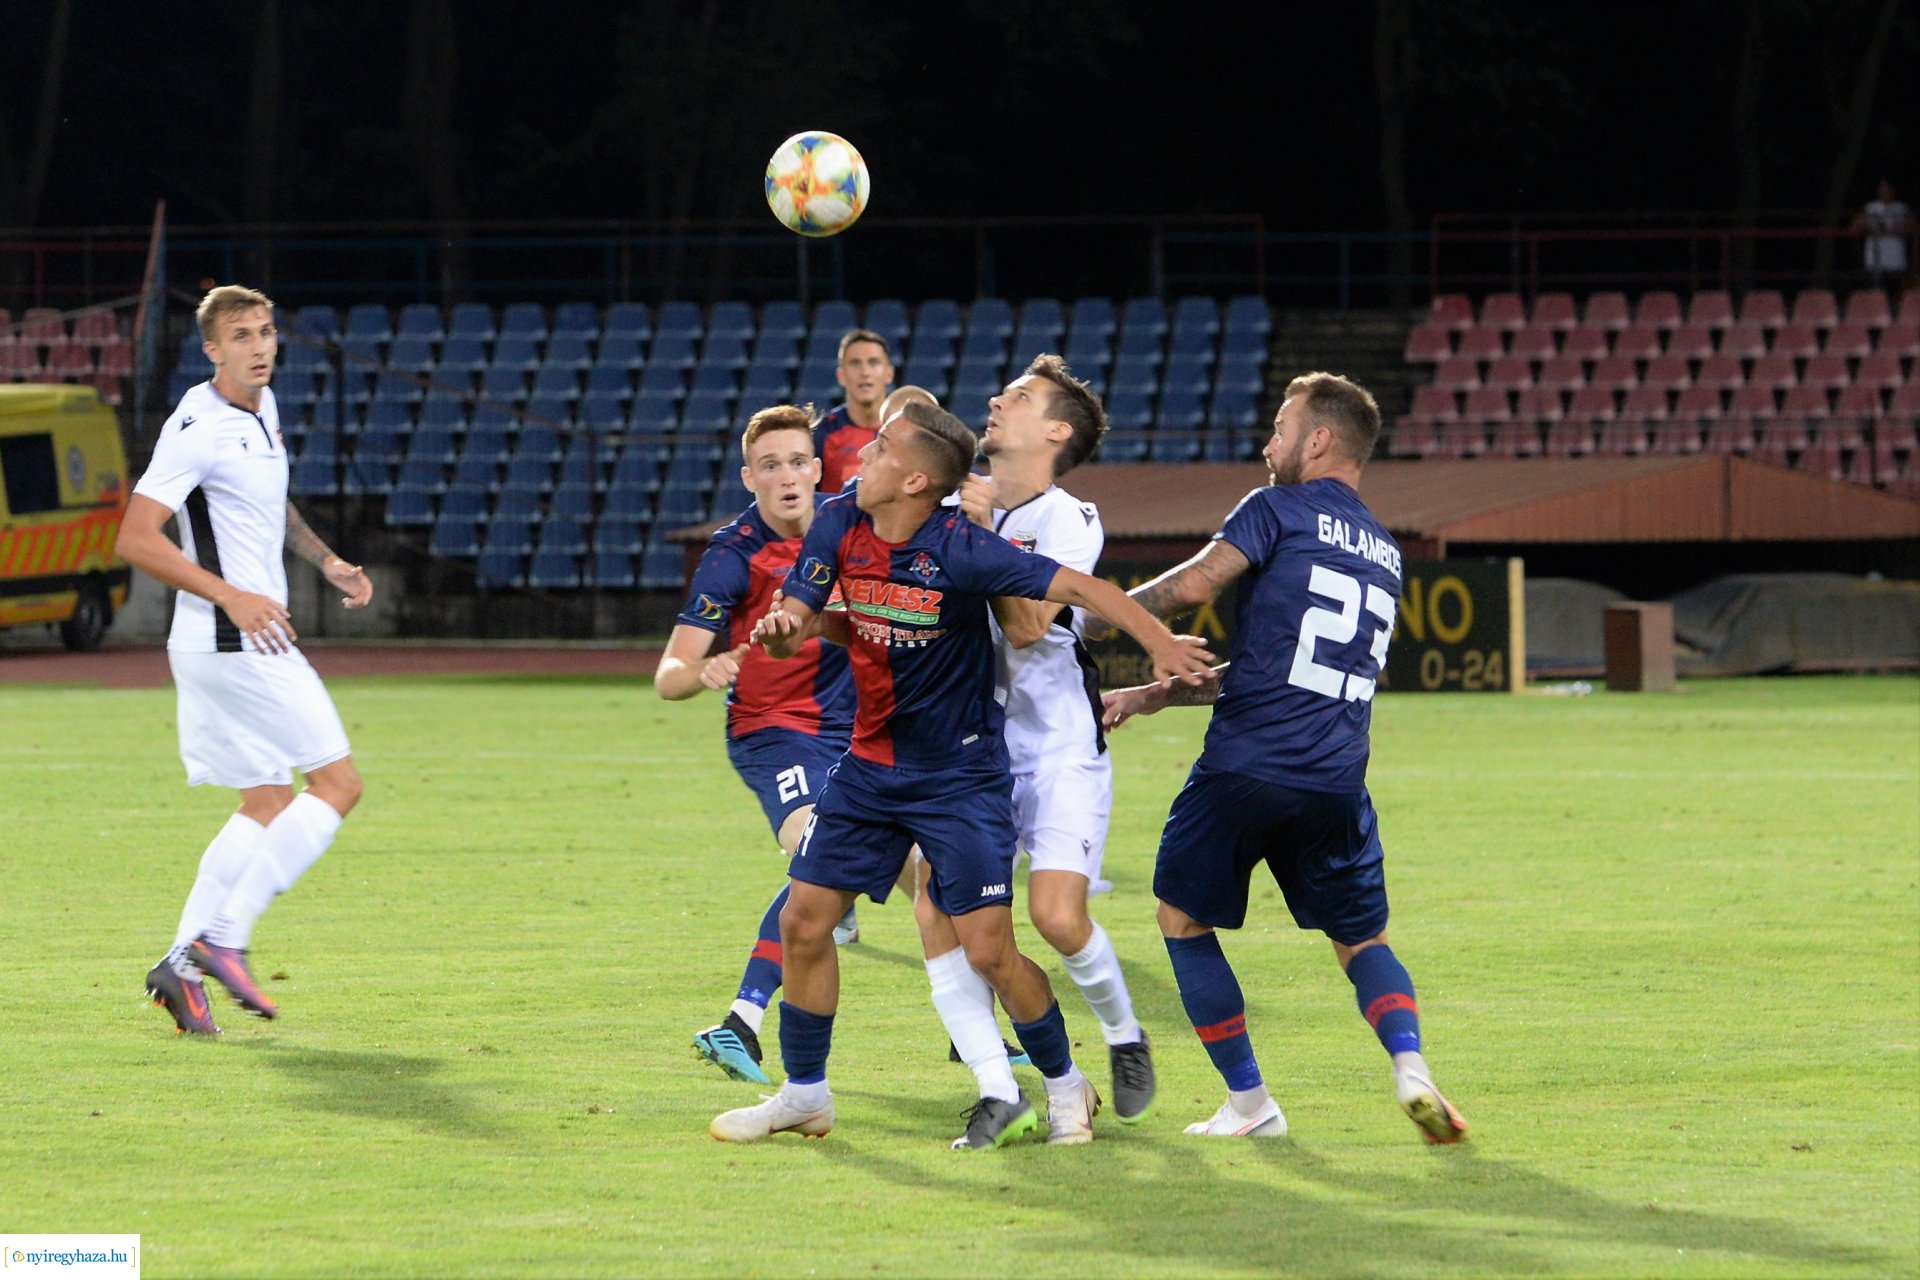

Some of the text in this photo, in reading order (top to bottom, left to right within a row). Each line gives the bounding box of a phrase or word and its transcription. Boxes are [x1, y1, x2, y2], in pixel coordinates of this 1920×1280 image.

[1317, 513, 1401, 581] GALAMBOS
[1288, 564, 1396, 703] 23
[1420, 648, 1504, 690] 0-24
[776, 765, 810, 804] 21
[981, 883, 1006, 897] JAKO
